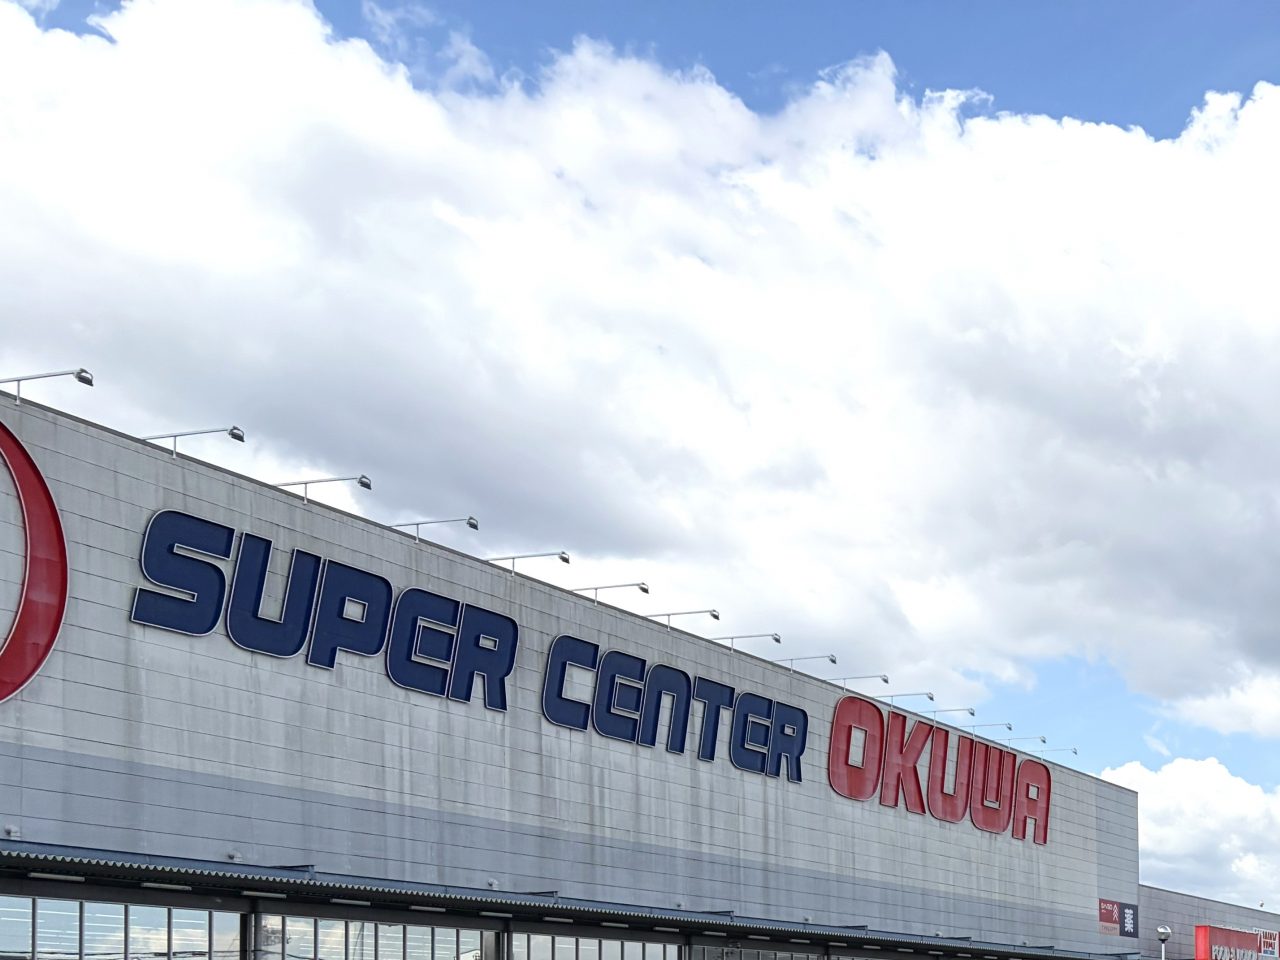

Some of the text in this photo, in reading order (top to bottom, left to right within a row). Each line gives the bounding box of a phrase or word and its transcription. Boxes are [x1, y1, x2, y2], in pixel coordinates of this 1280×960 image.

[130, 509, 1052, 845] SUPER CENTER OKUWA
[1124, 908, 1134, 933] 薬
